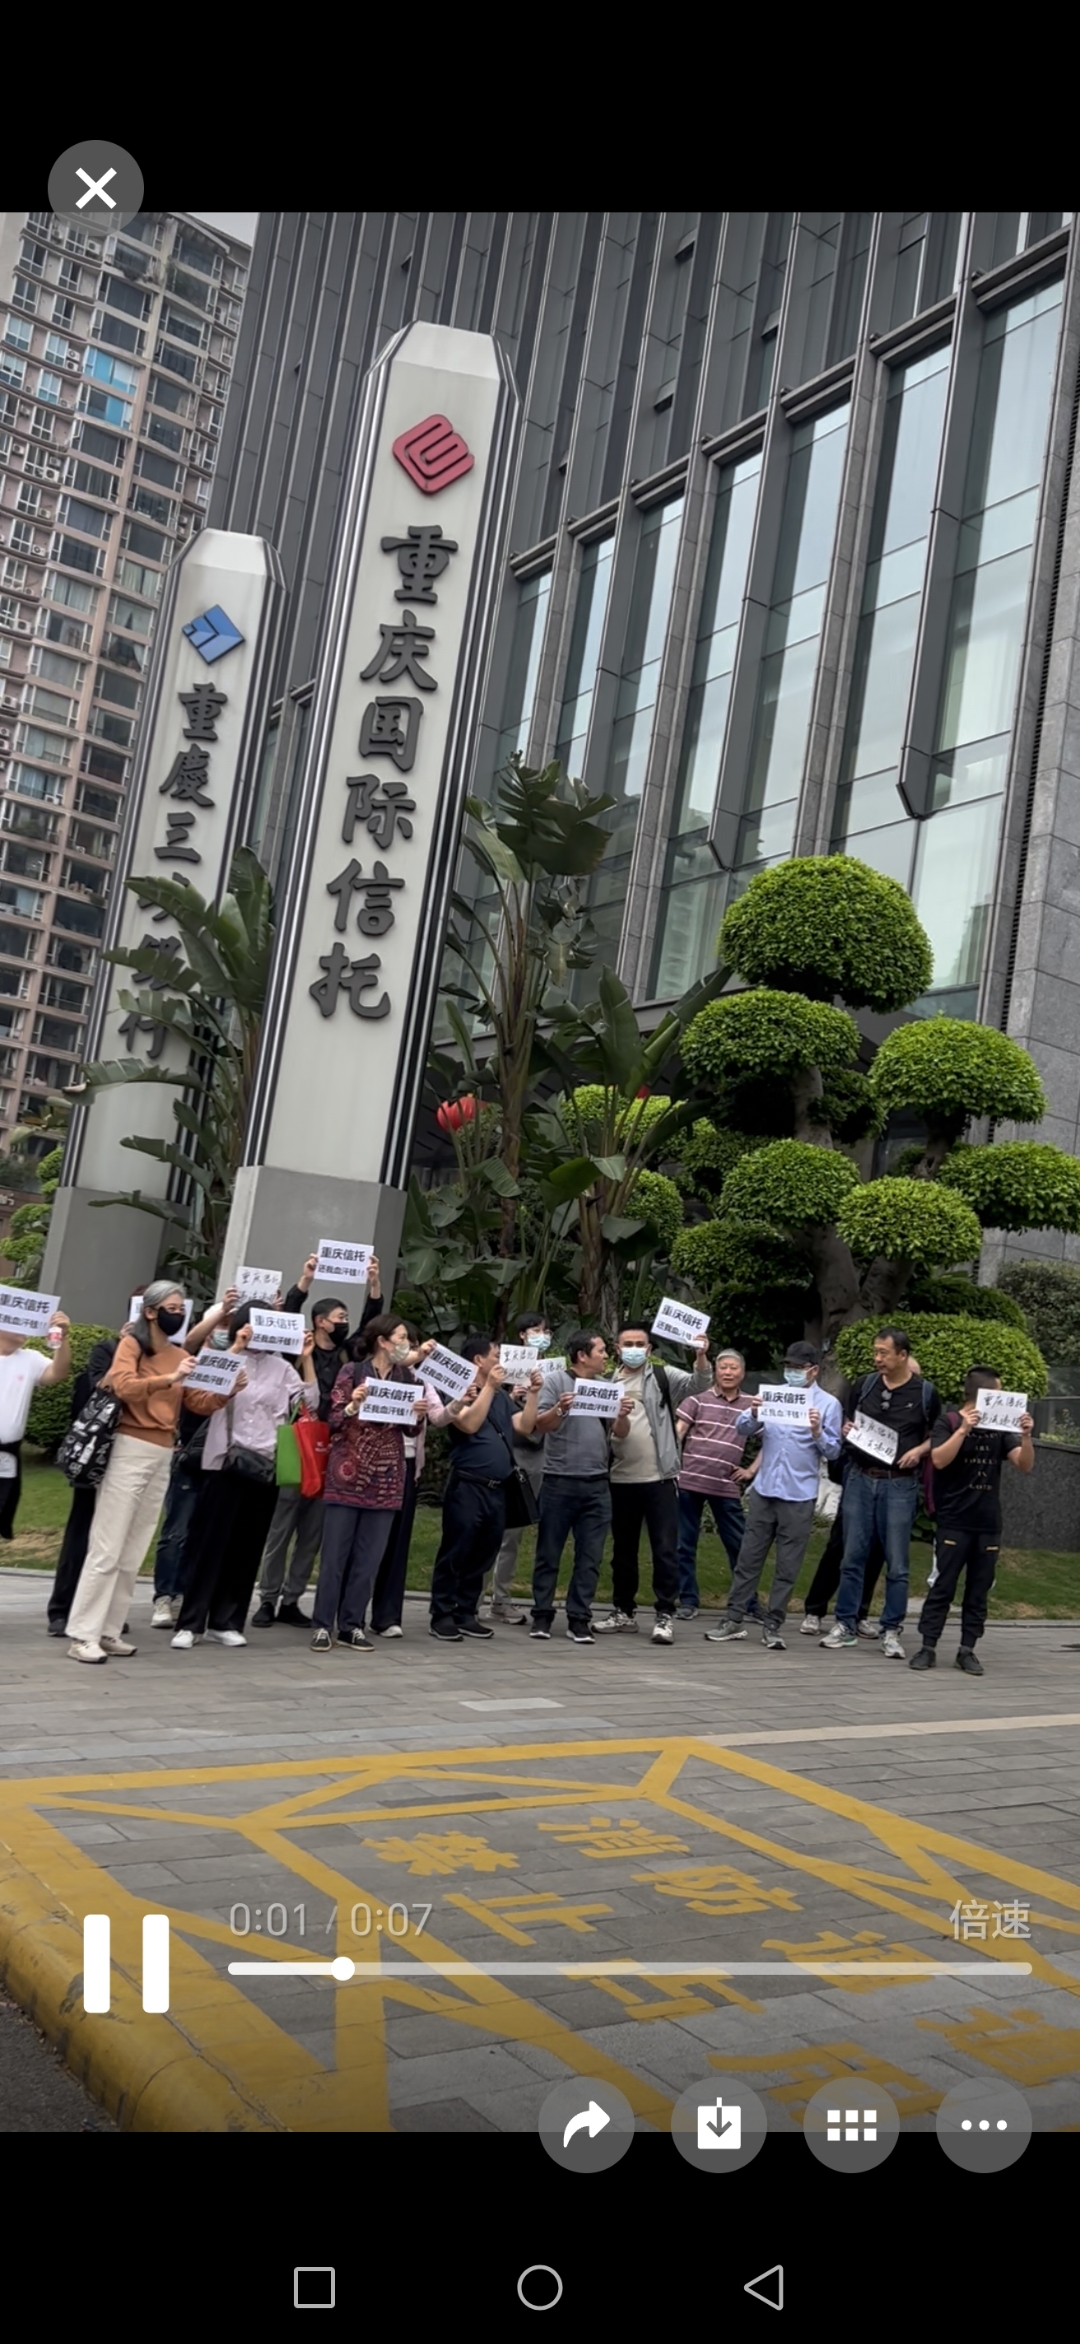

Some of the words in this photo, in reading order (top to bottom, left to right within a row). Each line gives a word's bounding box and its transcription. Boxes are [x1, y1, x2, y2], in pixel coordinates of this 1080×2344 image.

[309, 525, 458, 1021] 重庆国际信托
[320, 1246, 366, 1262] 重庆信托
[0, 1294, 50, 1314] 重庆信托
[254, 1314, 299, 1331] 重庆信托
[661, 1304, 703, 1330] 重庆信托
[199, 1354, 241, 1373] 重庆信托
[429, 1350, 472, 1380] 重庆信托
[368, 1385, 415, 1402] 重庆信托
[577, 1385, 619, 1401] 重庆信托
[762, 1390, 807, 1405] 重庆信托
[538, 1817, 1080, 2087] 消防通道
[361, 1830, 948, 2127] 禁止占用
